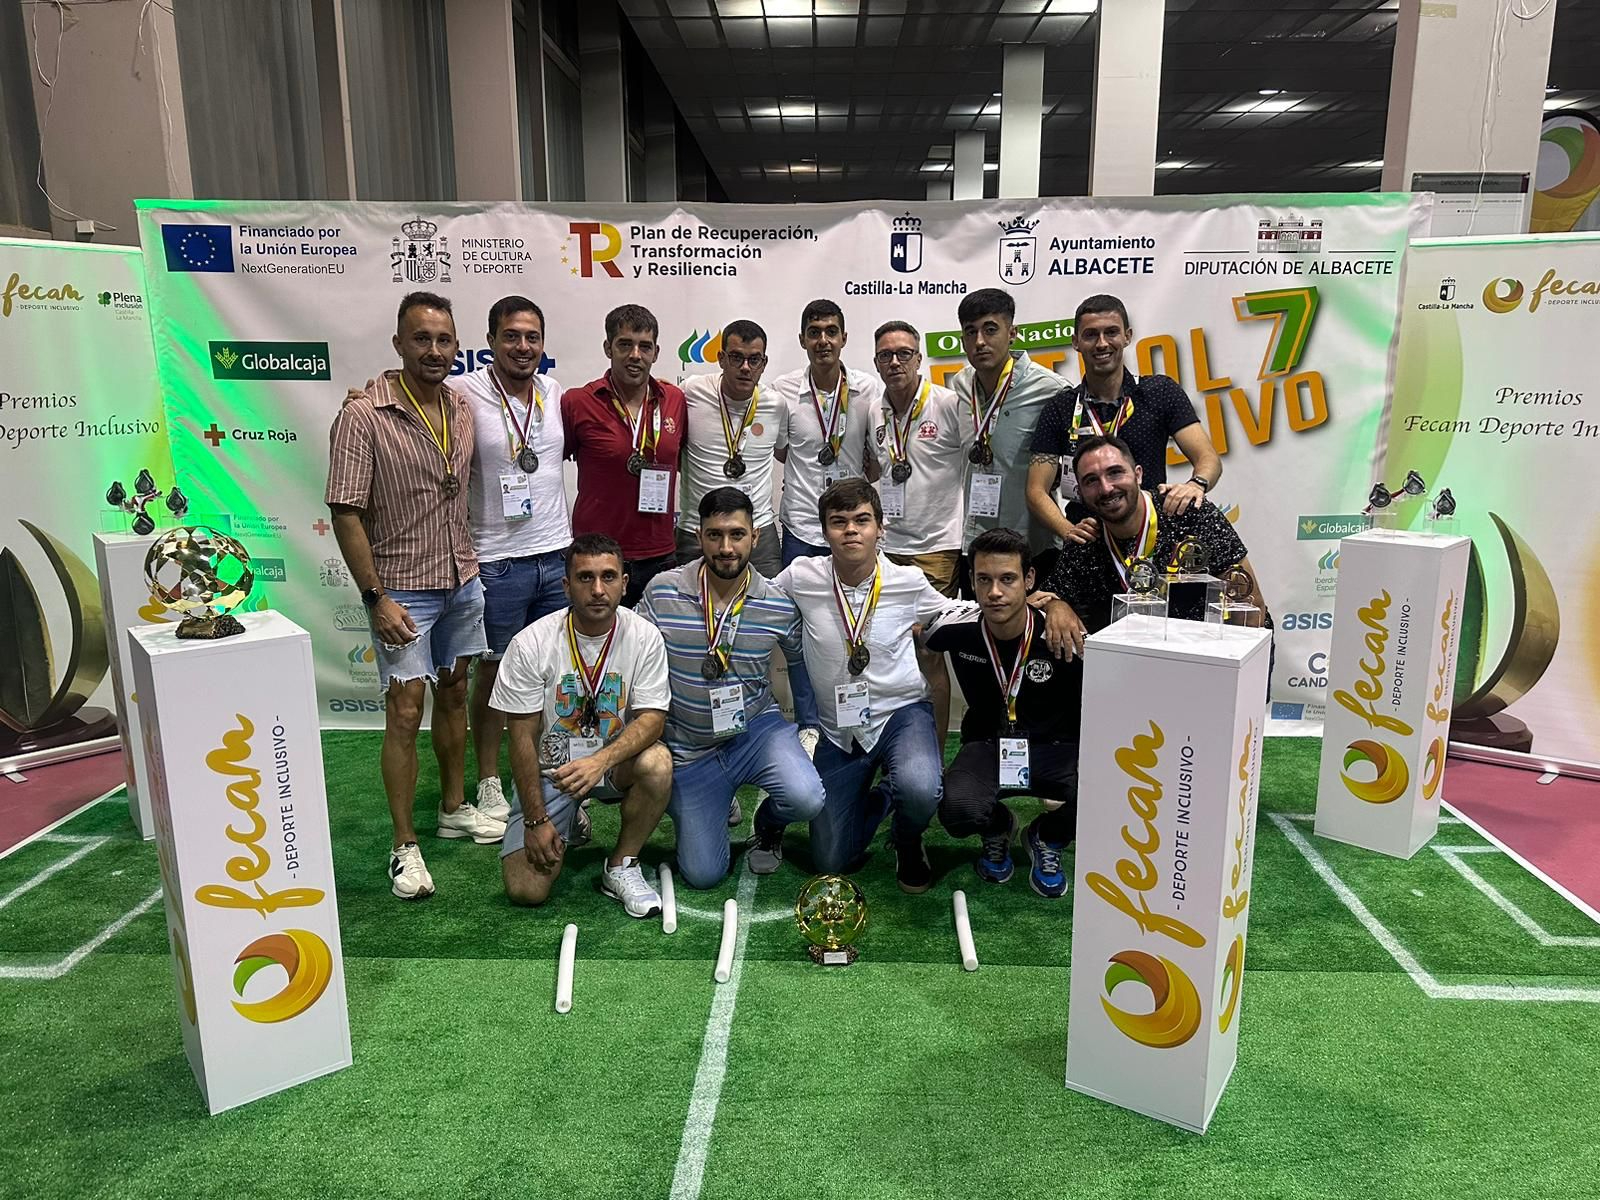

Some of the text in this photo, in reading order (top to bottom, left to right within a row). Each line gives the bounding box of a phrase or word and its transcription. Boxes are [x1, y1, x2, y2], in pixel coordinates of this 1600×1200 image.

[239, 225, 341, 241] Financiado por
[630, 225, 819, 242] Plan de Recuperación,
[240, 242, 357, 258] la Unión Europea
[462, 238, 525, 249] MINISTERIO
[630, 244, 762, 259] Transformación
[1049, 236, 1156, 254] Ayuntamiento
[463, 251, 532, 261] DE CULTURA
[241, 263, 345, 274] NextGenerationEU
[463, 264, 523, 274] Y DEPORTE
[633, 262, 737, 279] y Resiliencia
[1048, 257, 1155, 275] ALBACETE
[1184, 258, 1394, 275] DIPUTACIÓN DE ALBACETE
[0, 273, 84, 317] fecam
[844, 279, 967, 295] Castilla-La Mancha
[1529, 268, 1600, 313] feca
[113, 292, 142, 303] Plena
[1231, 286, 1320, 381] 7
[242, 353, 327, 375] Globalcaja
[1495, 387, 1584, 406] Premios
[74, 415, 160, 437] Inclusivo
[1404, 415, 1471, 433] Fecam
[1479, 417, 1564, 444] Deporte
[232, 429, 297, 443] Cruz Roja
[261, 523, 287, 531] Europea
[1282, 613, 1333, 631] asis
[1333, 588, 1414, 736] fecam
[1392, 604, 1411, 706] DEPORTE INCLUSIVO
[1288, 677, 1328, 688] CAND
[272, 725, 300, 871] DEPORTE INCLUSIVO
[194, 713, 326, 919] fecam
[1172, 745, 1194, 902] DEPORTE INCLUSIVO
[1085, 719, 1207, 948] fecam
